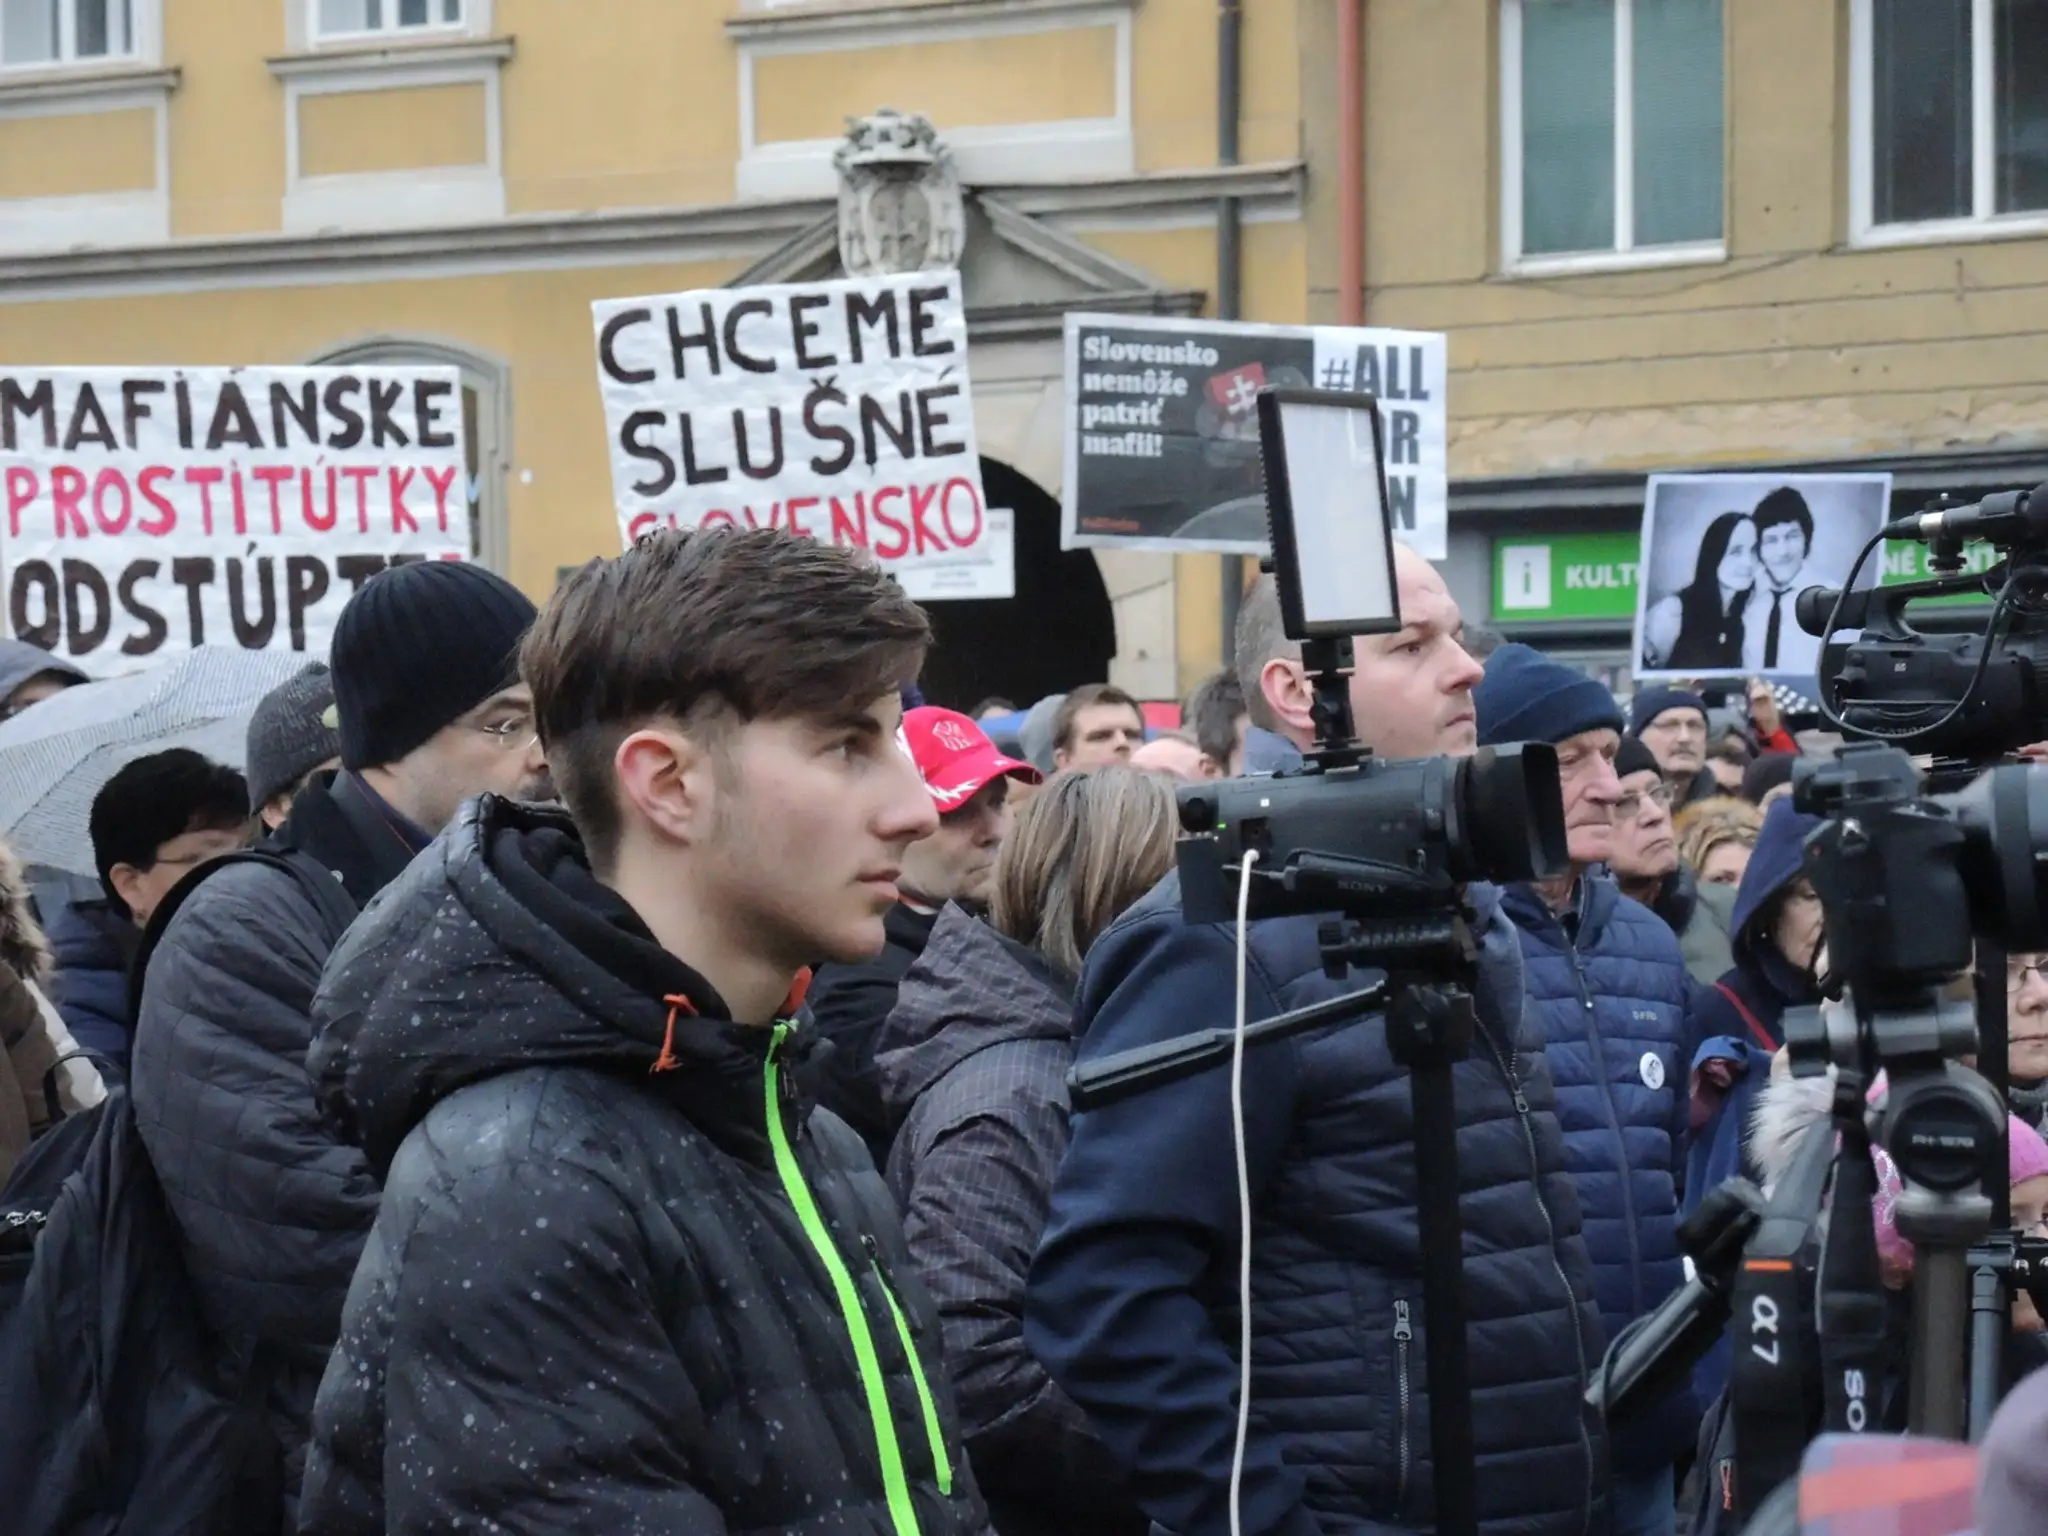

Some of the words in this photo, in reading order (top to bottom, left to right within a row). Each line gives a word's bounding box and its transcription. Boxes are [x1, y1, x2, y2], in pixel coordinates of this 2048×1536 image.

[599, 286, 954, 383] CHCEME
[1083, 335, 1219, 367] Slovensko
[1083, 368, 1188, 397] nemôže
[1321, 344, 1430, 402] #ALL
[1082, 397, 1164, 429] patriť
[620, 366, 966, 496] SLUŠNÉ
[1082, 431, 1163, 457] mafii!
[1565, 562, 1640, 590] KULT
[1844, 1370, 1867, 1432] SO
